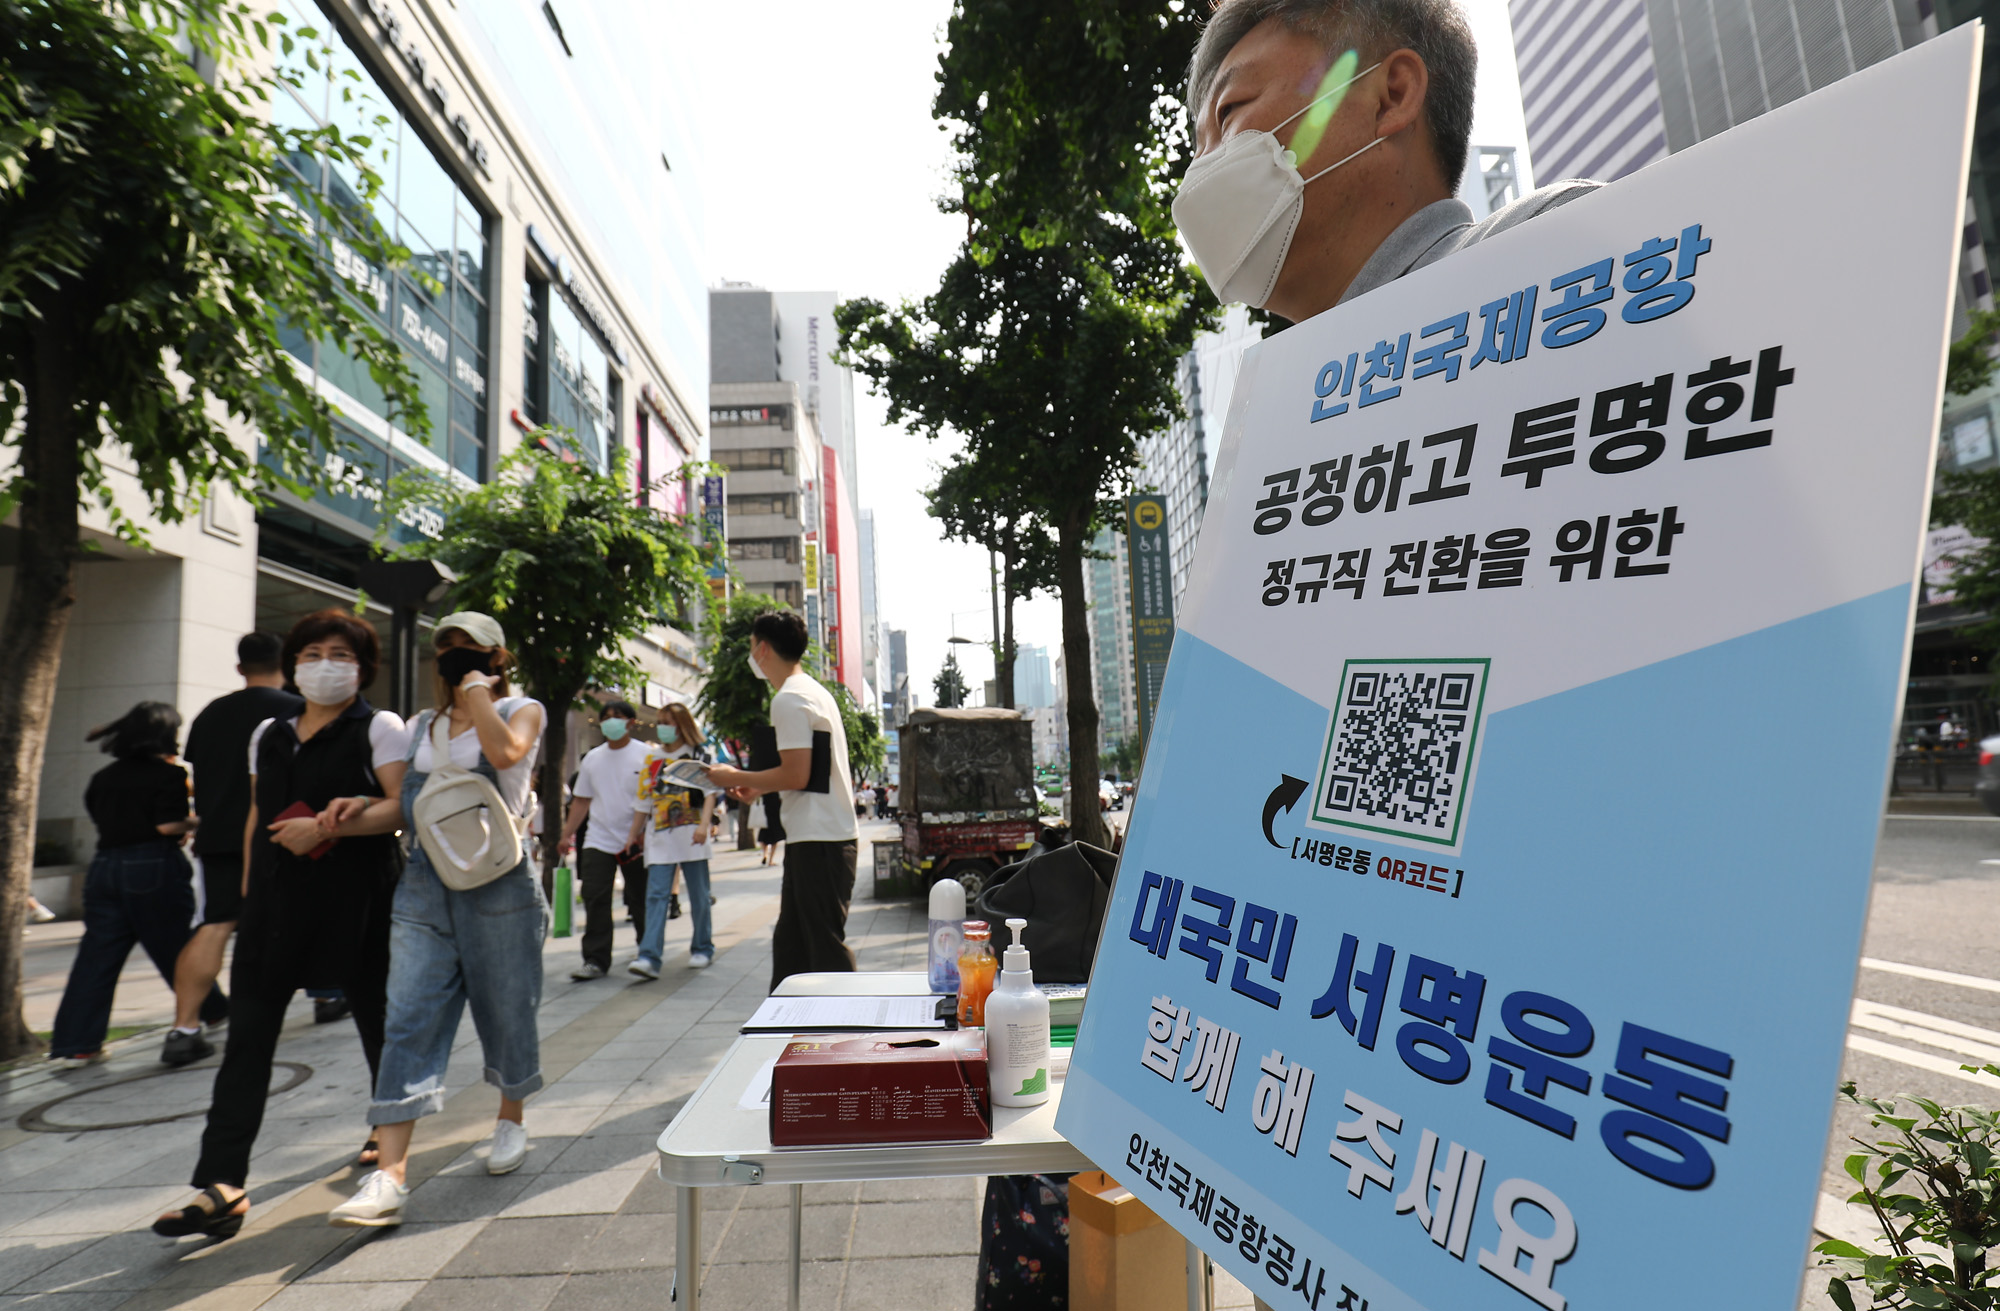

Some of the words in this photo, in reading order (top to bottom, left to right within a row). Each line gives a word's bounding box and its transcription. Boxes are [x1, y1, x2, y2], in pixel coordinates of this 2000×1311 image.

[331, 237, 389, 314] 법무사
[807, 316, 819, 381] Mercure
[1310, 223, 1710, 424] 인천국제공항
[1252, 423, 1478, 536] 공정하고
[1500, 345, 1795, 489] 투명한
[1262, 547, 1372, 607] 정규직
[1383, 527, 1531, 597] 전환을
[1549, 506, 1685, 583] 위한
[1129, 869, 1298, 1010] 대국민
[1310, 932, 1735, 1191] 서명운동
[1126, 1133, 1326, 1311] 인천국제공항공사
[1141, 995, 1241, 1112] 함께
[1252, 1049, 1315, 1158] 해
[1328, 1089, 1578, 1311] 주세요
